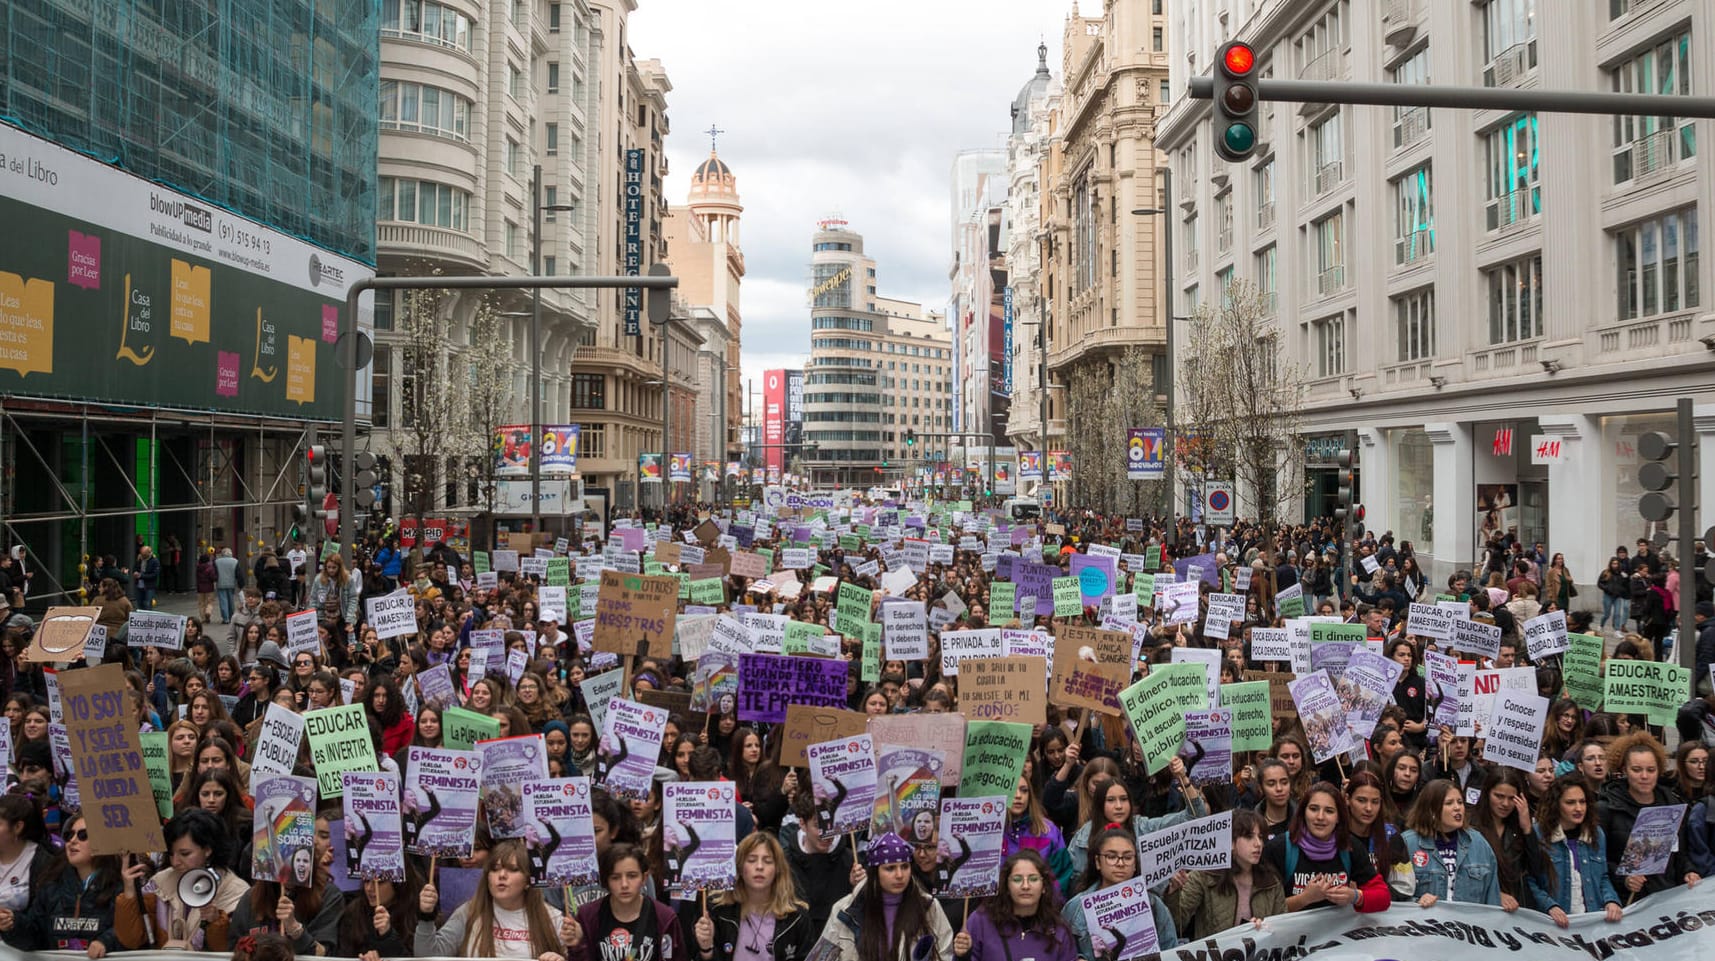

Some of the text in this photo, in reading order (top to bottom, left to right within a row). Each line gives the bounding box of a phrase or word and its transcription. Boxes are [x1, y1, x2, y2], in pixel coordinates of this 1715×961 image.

[10, 157, 57, 185] del Libro
[627, 172, 640, 236] HOTEL
[218, 219, 234, 243] (91)
[237, 230, 249, 247] 515
[252, 236, 260, 251] 94
[72, 251, 96, 266] Gracias
[72, 267, 98, 279] por Leer
[132, 290, 150, 306] Casa
[141, 307, 150, 319] del
[131, 314, 150, 332] Libro
[262, 320, 274, 333] Casa
[261, 343, 275, 355] Libro
[543, 432, 577, 456] 8M
[1129, 437, 1163, 461] 8M
[1493, 429, 1512, 456] H&M
[1537, 441, 1560, 458] H&M
[671, 457, 691, 471] 8M
[1021, 456, 1041, 470] 8M
[1054, 579, 1079, 591] EDUCAR
[840, 586, 870, 606] EDUCAR
[1239, 596, 1245, 604] O
[599, 599, 632, 612] TODAS
[1411, 604, 1452, 619] EDUCAR, O
[893, 610, 916, 620] Educar
[598, 612, 665, 635] NOSOTRAS
[895, 622, 924, 631] derechos
[1410, 616, 1450, 631] AMAESTRAR?
[1456, 620, 1499, 639] EDUCAR, O
[1526, 619, 1564, 639] MENTES LIBRES
[1003, 631, 1030, 641] 6 Marzo
[1313, 630, 1362, 641] El dinero
[1456, 632, 1499, 650] AMAESTRAR?
[1576, 639, 1601, 648] dinero
[1009, 647, 1046, 657] FEMINISTA
[1097, 641, 1122, 654] ÚNICA
[742, 656, 822, 673] TE PREFIERO
[1100, 654, 1129, 664] SANGRE
[1426, 652, 1445, 664] 6 Marzo
[743, 668, 847, 685] CUANDO ERES TÚ
[1431, 670, 1457, 685] FEMINISTA
[1609, 664, 1677, 683] EDUCAR, O
[592, 680, 618, 696] Educar
[744, 679, 843, 698] MISMA LA QUE
[1126, 698, 1137, 712] El
[1138, 680, 1168, 704] dinero
[1608, 683, 1676, 702] AMAESTRAR?
[66, 690, 124, 721] YO SOY
[1222, 692, 1267, 706] La educación,
[610, 700, 643, 715] 6 Marzo
[977, 700, 1013, 717] COÑO
[1237, 708, 1265, 722] derecho,
[1504, 699, 1536, 717] Conocer
[306, 711, 365, 736] EDUCAR
[1185, 712, 1208, 721] Marzo
[1497, 714, 1536, 733] y respetar
[613, 722, 661, 742] FEMINISTA
[1142, 712, 1182, 744] a la escuela
[1186, 727, 1230, 739] FEMINISTA
[1236, 724, 1269, 740] negocio!
[76, 720, 129, 753] Y SERÉ
[967, 732, 1024, 751] La educación,
[1489, 726, 1538, 750] la diversidad
[259, 739, 294, 770] PÚBLICAS
[315, 738, 372, 765] es INVERTIR,
[410, 750, 452, 763] 6 Marzo
[810, 743, 846, 758] 6 Marzo
[1486, 743, 1535, 764] en lo sexual.
[80, 751, 141, 778] LO QUE YO
[822, 758, 873, 776] FEMINISTA
[967, 751, 1015, 771] un derecho,
[344, 776, 374, 787] 6 Marzo
[418, 774, 478, 789] FEMINISTA
[523, 784, 561, 795] 6 Marzo
[666, 786, 705, 797] 6 Marzo
[352, 799, 397, 811] FEMINISTA
[535, 804, 590, 817] FEMINISTA
[943, 802, 980, 813] 6 Marzo
[102, 804, 133, 828] SER
[296, 817, 312, 825] SER
[676, 809, 733, 820] FEMINISTA
[951, 821, 1002, 833] FEMINISTA
[277, 834, 314, 846] SOMOS
[1140, 818, 1231, 854] Escuela y medios:
[1156, 837, 1216, 865] PRIVATIZAN
[1145, 852, 1227, 885] PARA ENGAÑAR
[1083, 890, 1119, 909] 6 Marzo
[1097, 900, 1149, 926] FEMINISTA
[1493, 929, 1523, 951] y
[1513, 926, 1560, 948] la
